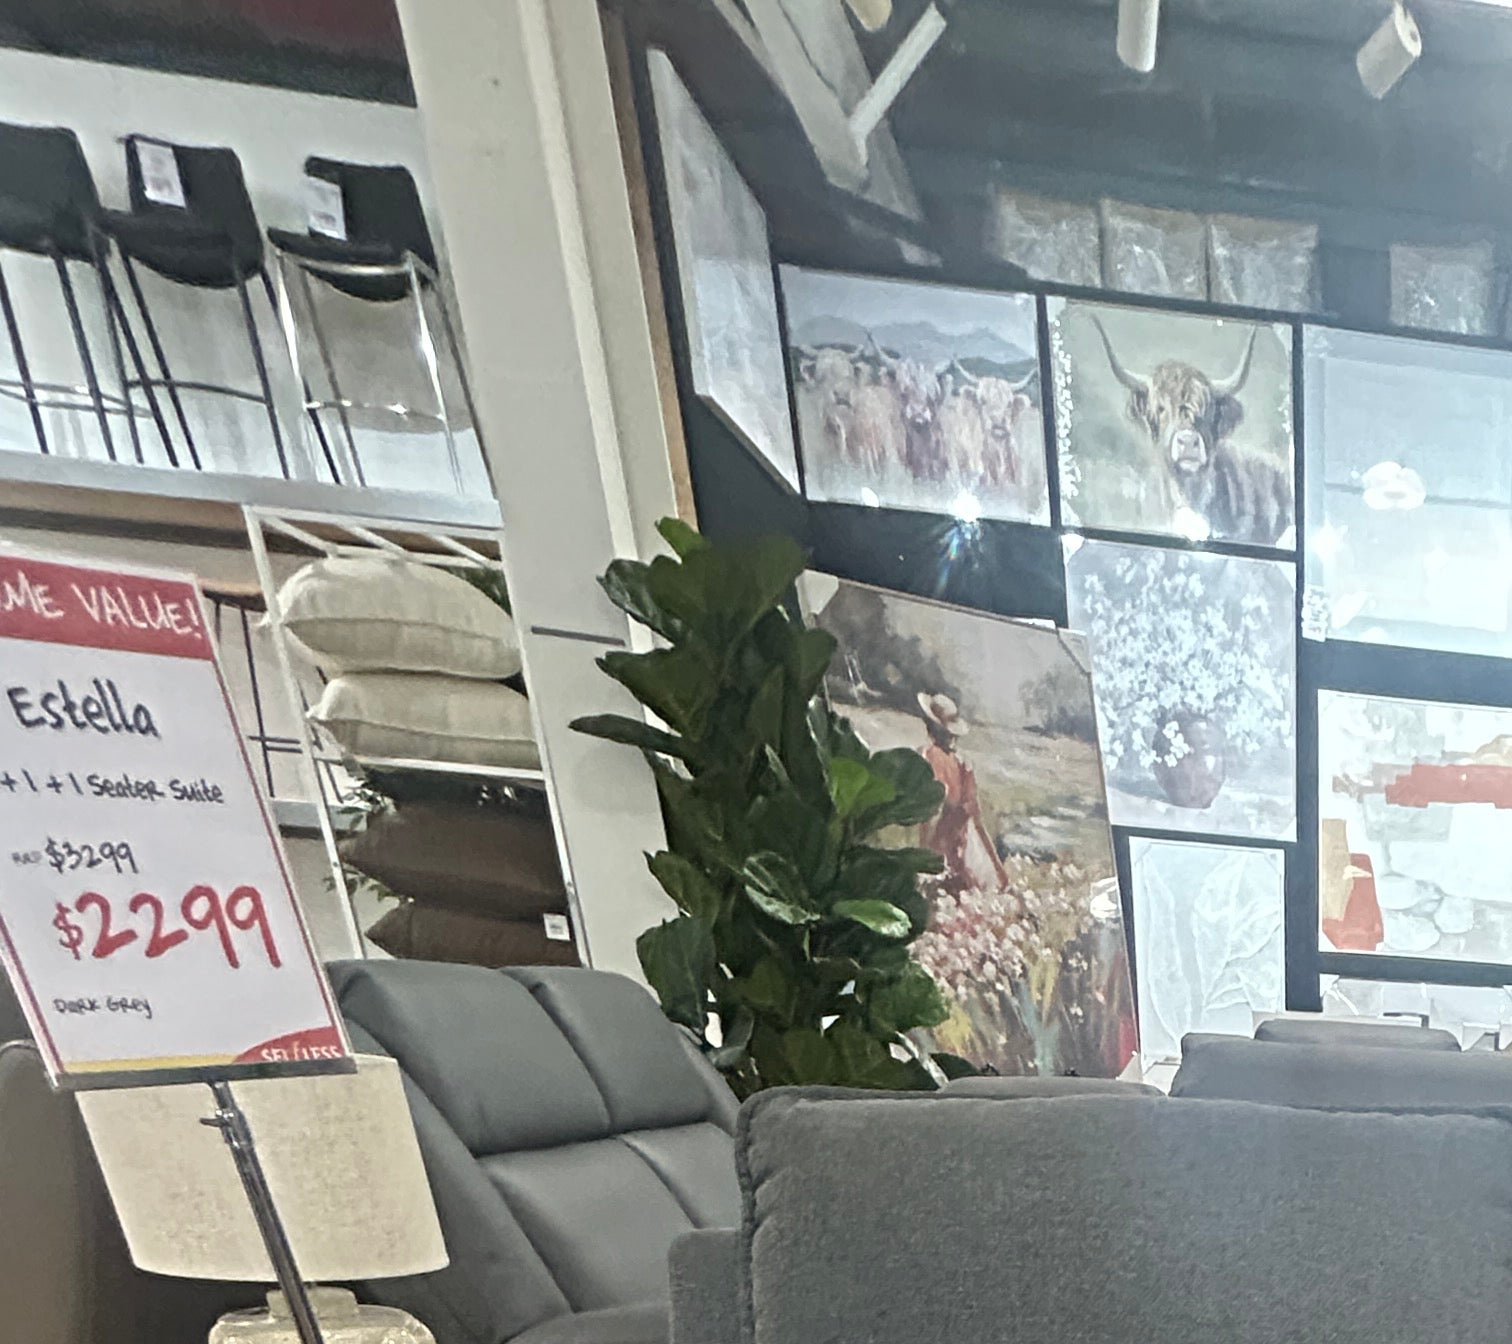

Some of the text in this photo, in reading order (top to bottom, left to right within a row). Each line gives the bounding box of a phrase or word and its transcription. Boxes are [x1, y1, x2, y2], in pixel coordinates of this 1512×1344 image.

[70, 582, 203, 640] VALUE!
[7, 677, 162, 740] Estella
[168, 778, 225, 804] Suite
[45, 835, 140, 876] $3299
[52, 884, 282, 970] $2299
